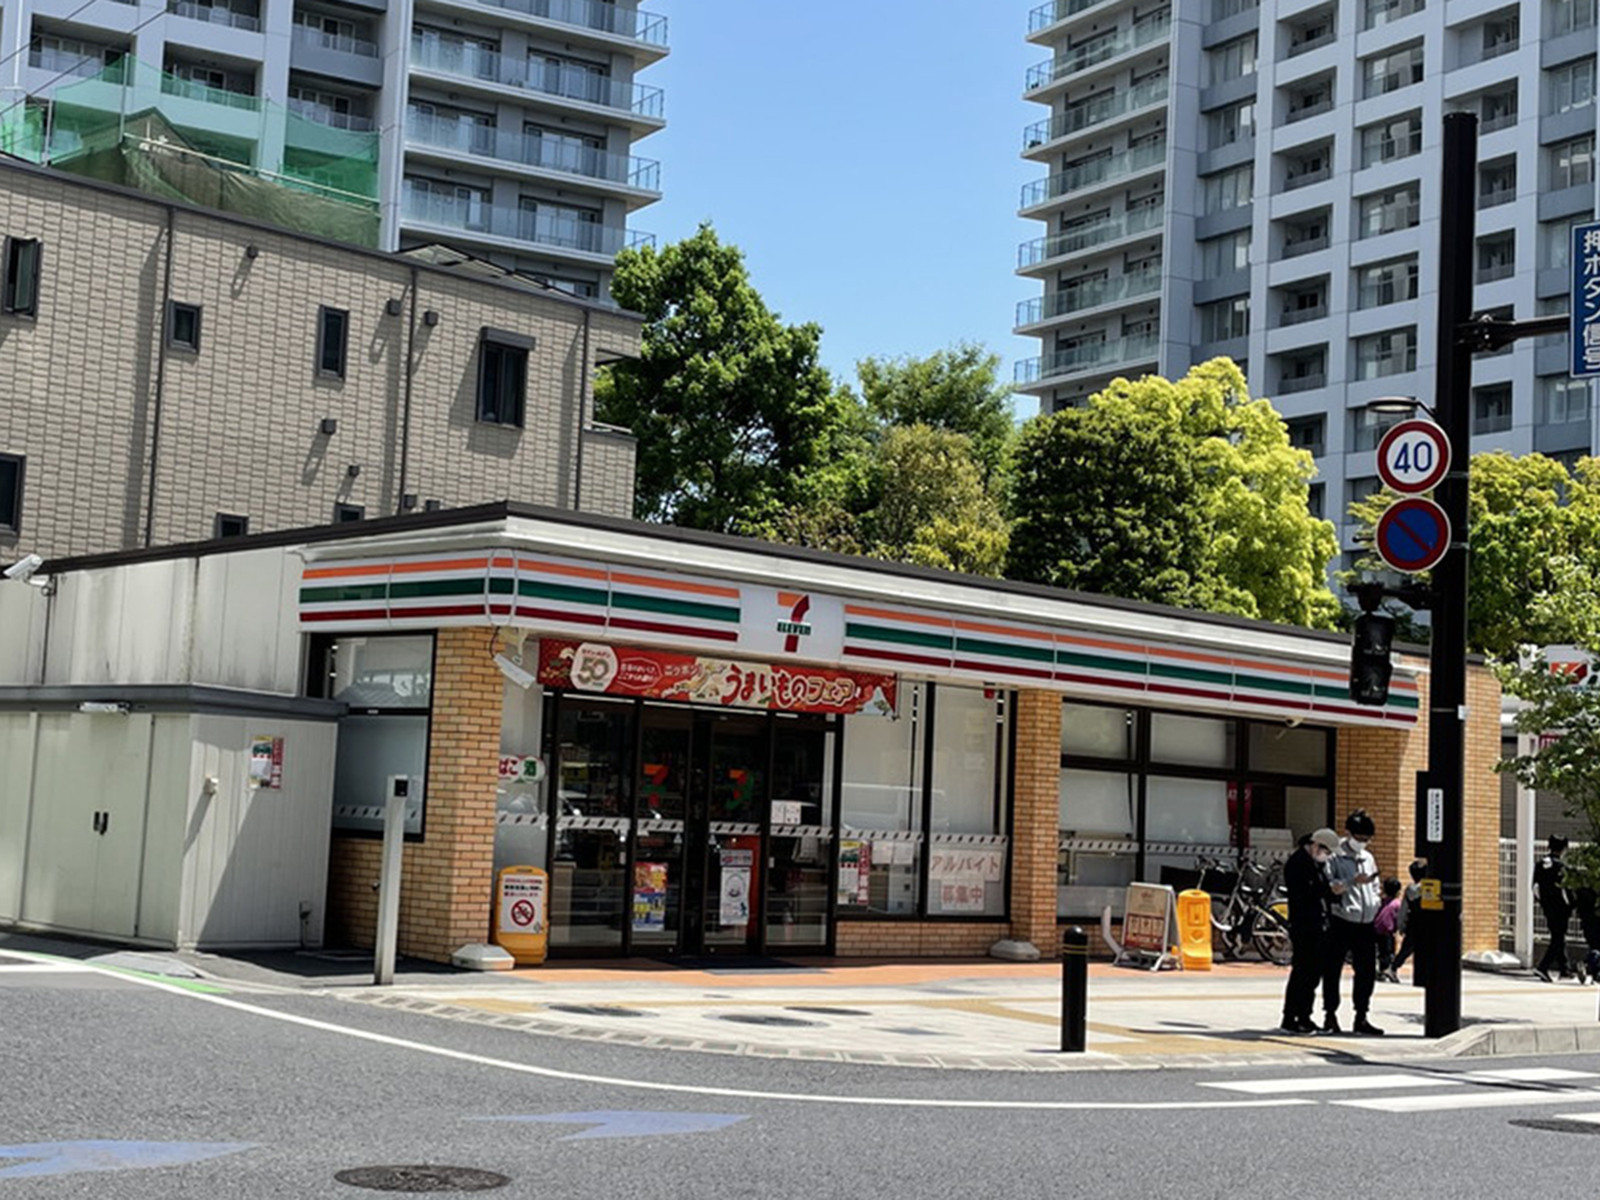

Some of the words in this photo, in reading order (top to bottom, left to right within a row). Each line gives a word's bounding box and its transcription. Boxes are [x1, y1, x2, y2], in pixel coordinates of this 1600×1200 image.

[1393, 441, 1432, 474] 40
[577, 656, 610, 685] 50
[931, 854, 1000, 874] アルバイト
